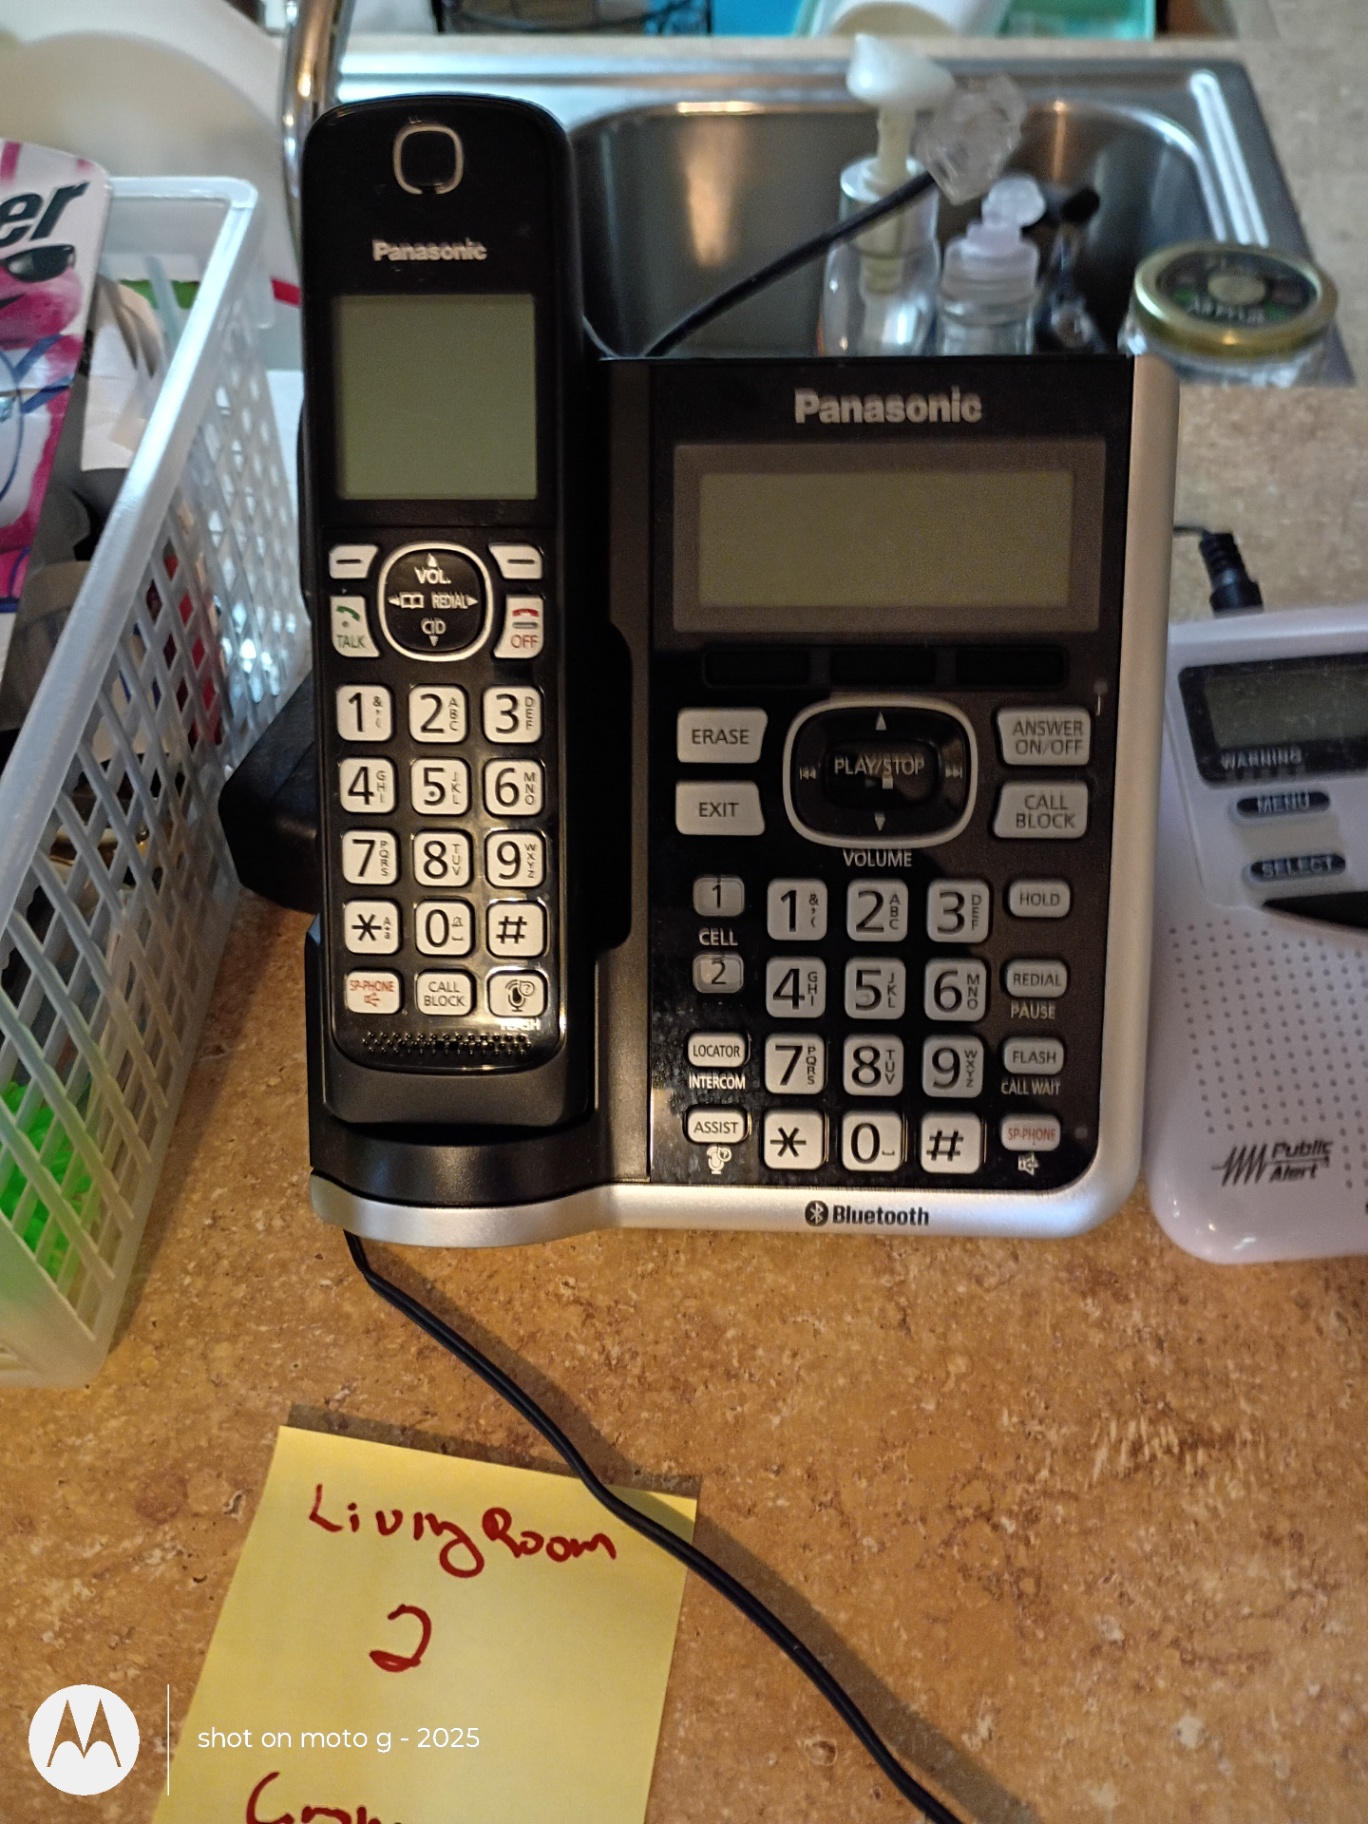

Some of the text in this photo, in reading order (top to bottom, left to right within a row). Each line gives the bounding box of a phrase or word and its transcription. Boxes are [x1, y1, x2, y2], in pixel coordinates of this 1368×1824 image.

[371, 238, 488, 261] Panasonic
[793, 386, 983, 424] Panasonic
[431, 592, 468, 610] REDIAL
[337, 634, 366, 649] TALK
[510, 635, 539, 649] OFF
[348, 691, 365, 733] 1
[419, 692, 445, 734] 2
[494, 692, 520, 735] 3
[691, 729, 750, 746] ERASE
[1012, 719, 1084, 737] ANSWER
[1014, 739, 1083, 756] ON/OFF
[833, 756, 926, 776] PLAY/STOP
[347, 765, 375, 806] 4
[422, 766, 447, 807] 5
[494, 767, 520, 809] 6
[698, 802, 740, 818] EXIT
[1024, 793, 1069, 811] CALL
[1256, 792, 1311, 814] MENU
[1015, 812, 1076, 829] BLOCK
[351, 838, 376, 878] 7
[422, 840, 449, 880] 8
[496, 840, 522, 881] 9
[842, 849, 913, 868] VOLUME
[710, 884, 723, 909] 1
[1019, 893, 1060, 907] HOLD
[780, 889, 798, 933] 1
[855, 890, 885, 934] 2
[937, 890, 966, 935] 3
[425, 909, 450, 948] 0
[496, 916, 527, 945] #
[699, 928, 738, 947] CELL
[710, 959, 727, 985] 2
[1012, 973, 1063, 987] REDIAL
[349, 980, 395, 992] SP-PHONE
[428, 981, 460, 993] CALL
[772, 967, 806, 1011] 4
[855, 968, 882, 1012] 5
[933, 970, 963, 1014] 6
[423, 995, 465, 1007] BLOCK
[1010, 1004, 1056, 1020] PAUSE
[692, 1044, 741, 1058] LOCATOR
[1012, 1051, 1057, 1064] FLASH
[774, 1045, 804, 1087] 7
[852, 1045, 882, 1088] 8
[931, 1047, 962, 1089] 9
[688, 1074, 746, 1090] INTERCOM
[1000, 1079, 1061, 1095] CALL WAIT
[693, 1120, 739, 1135] ASSIST
[1007, 1127, 1056, 1141] SP-PHONE
[851, 1122, 880, 1164] 0
[926, 1129, 964, 1161] #
[1271, 1139, 1334, 1159] Public
[832, 1203, 930, 1227] Bluetooth
[481, 1507, 617, 1562] Room
[369, 1603, 432, 1673] 2
